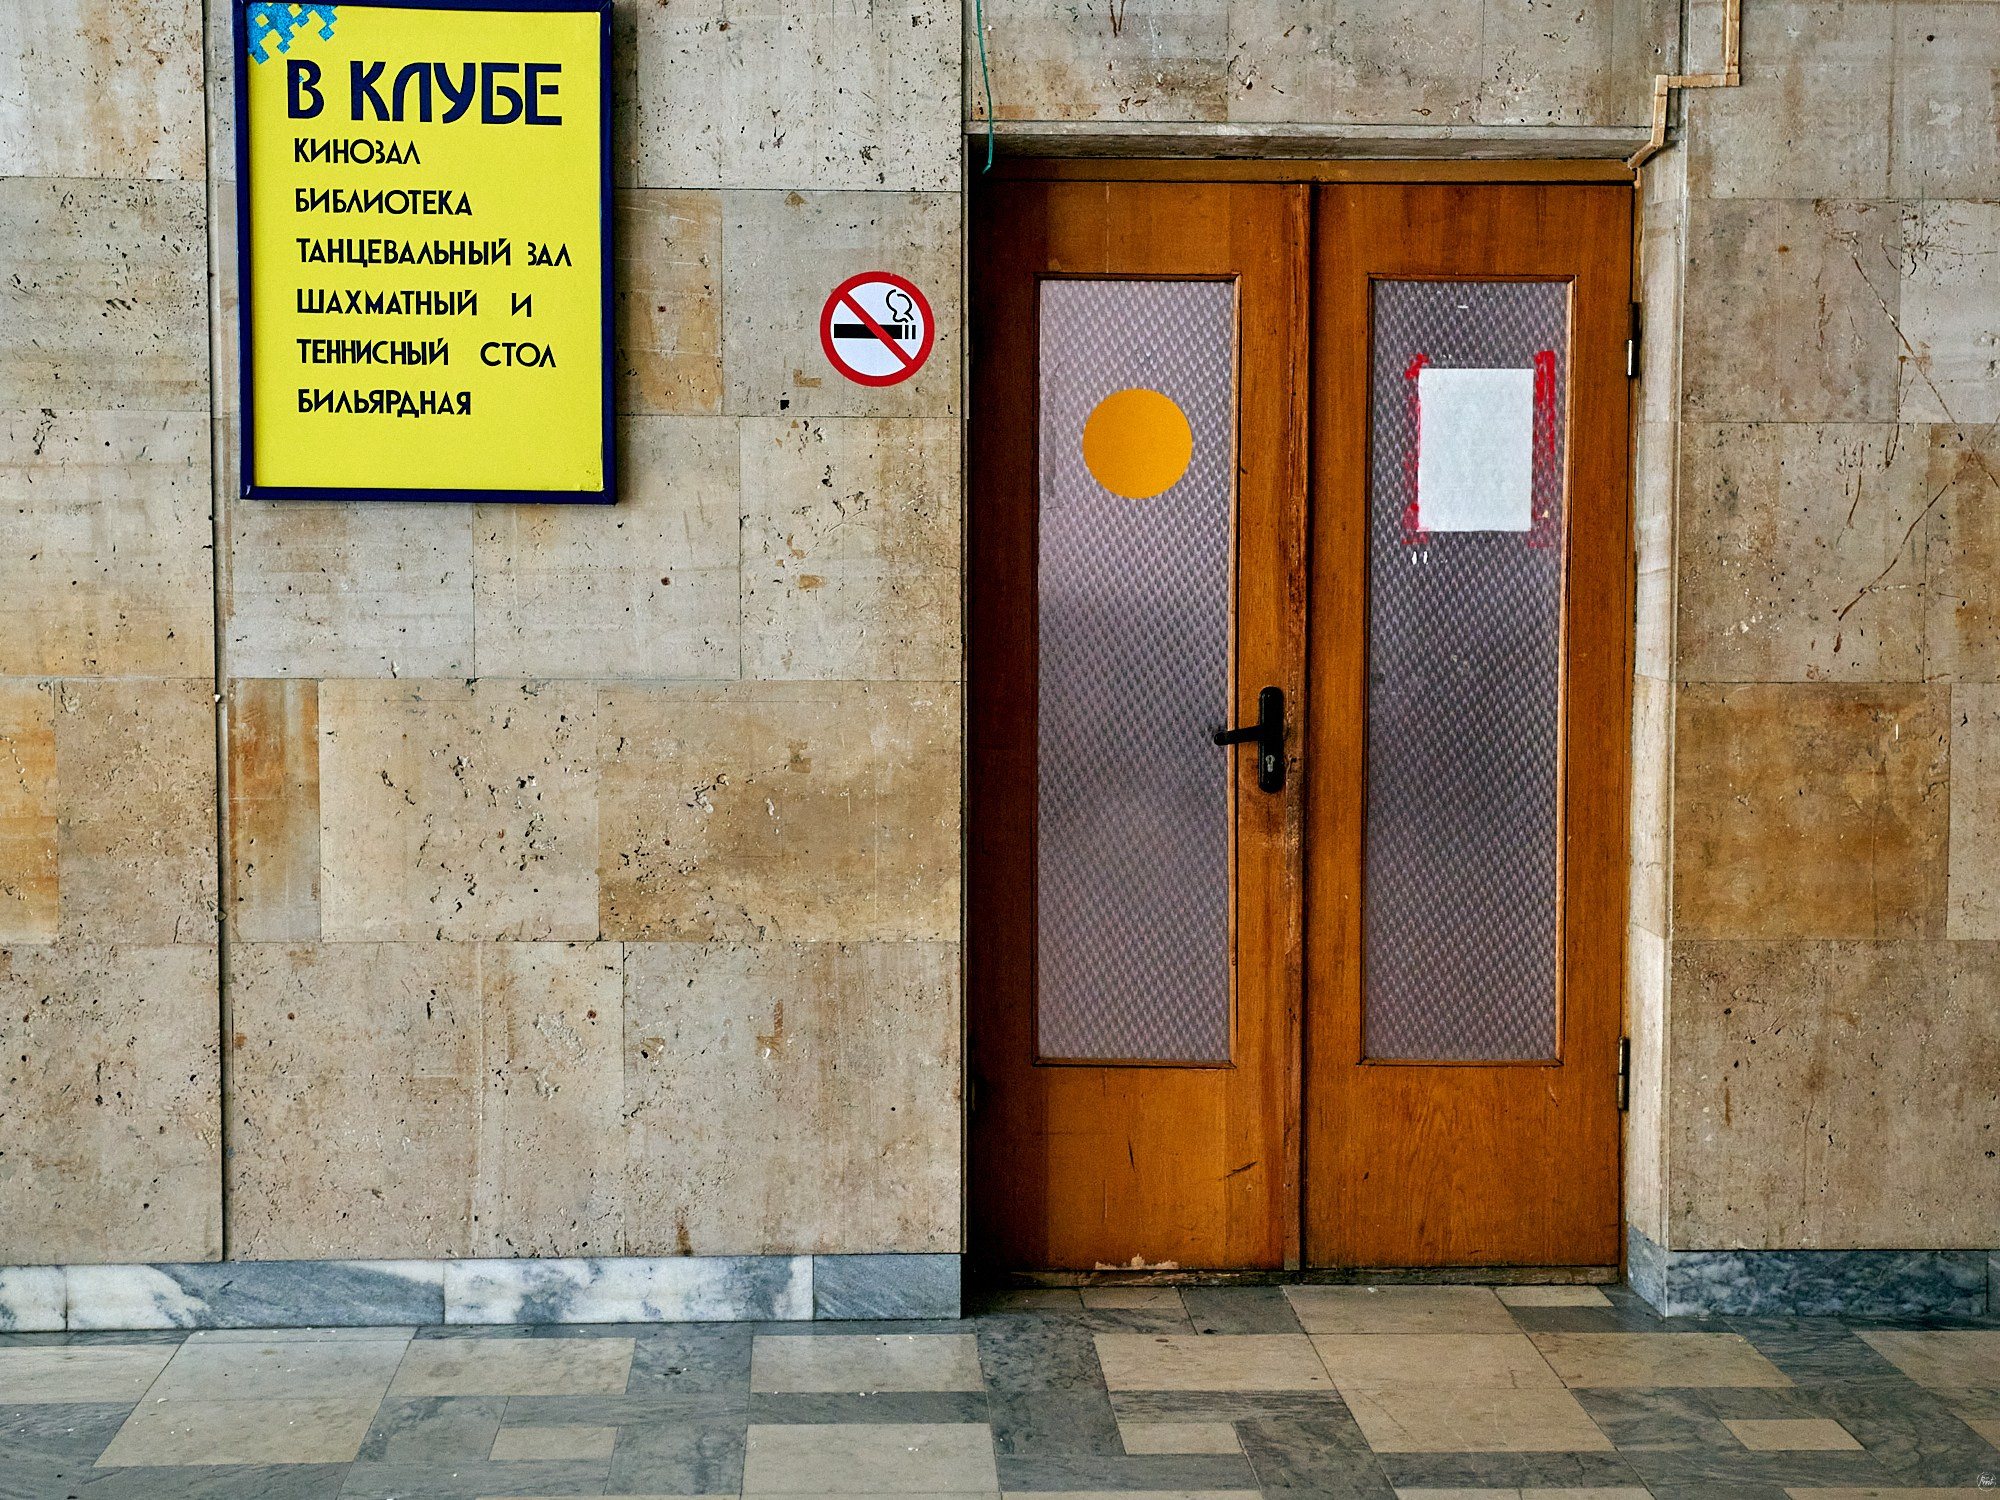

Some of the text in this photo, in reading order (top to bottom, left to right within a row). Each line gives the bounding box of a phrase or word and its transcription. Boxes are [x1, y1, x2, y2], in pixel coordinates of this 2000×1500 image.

[286, 59, 563, 125] В КЛУБЕ
[294, 137, 421, 165] КИНОЗАЛ
[295, 188, 473, 216] БИБЛИОТЕКА
[296, 238, 572, 267] ТАНЦЕВАЛЬНЫЙ ЗАЛ
[296, 288, 532, 318] ШАХМАТНЫЙ И
[296, 337, 557, 368] ТЕННИСНЫЙ СТОЛ
[297, 388, 471, 418] БИЛЬЯРДНАЯ
